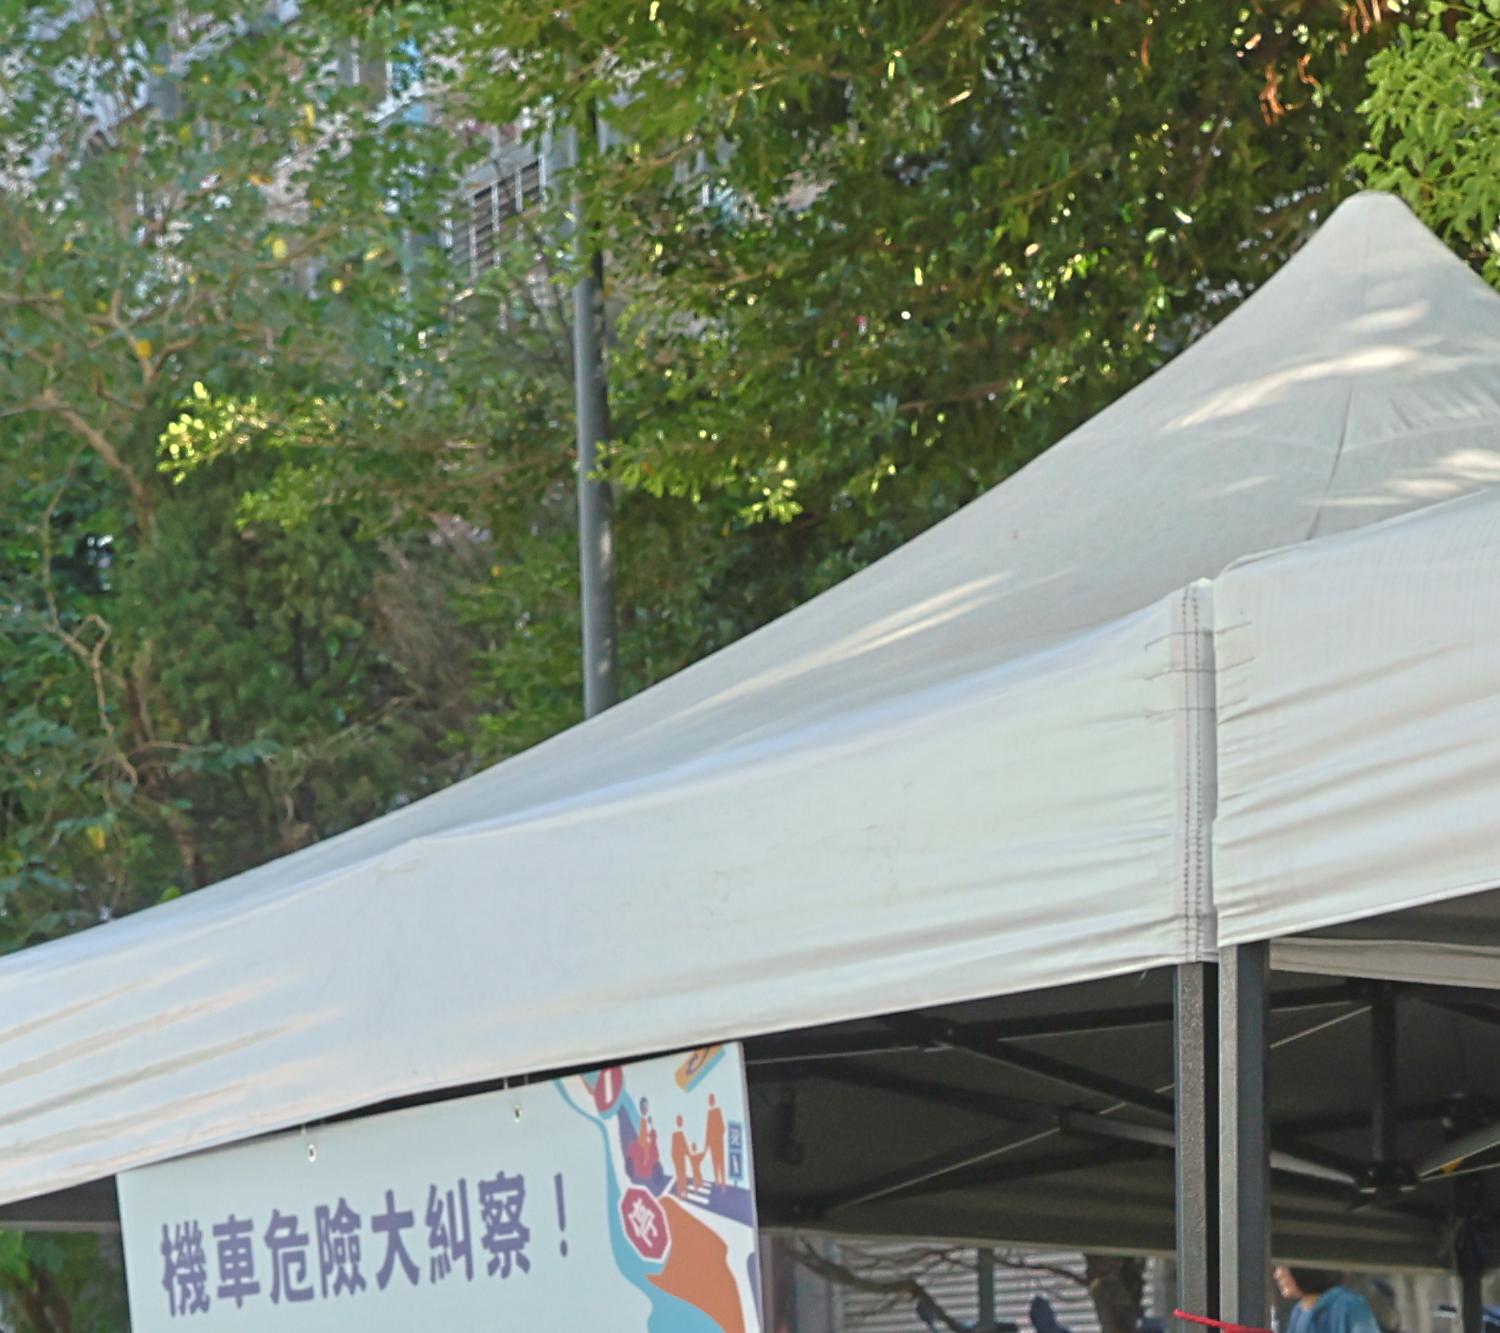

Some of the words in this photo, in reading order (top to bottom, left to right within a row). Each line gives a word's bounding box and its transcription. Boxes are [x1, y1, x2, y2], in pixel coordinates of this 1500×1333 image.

[160, 1169, 570, 1318] 機車危險大糾察！
